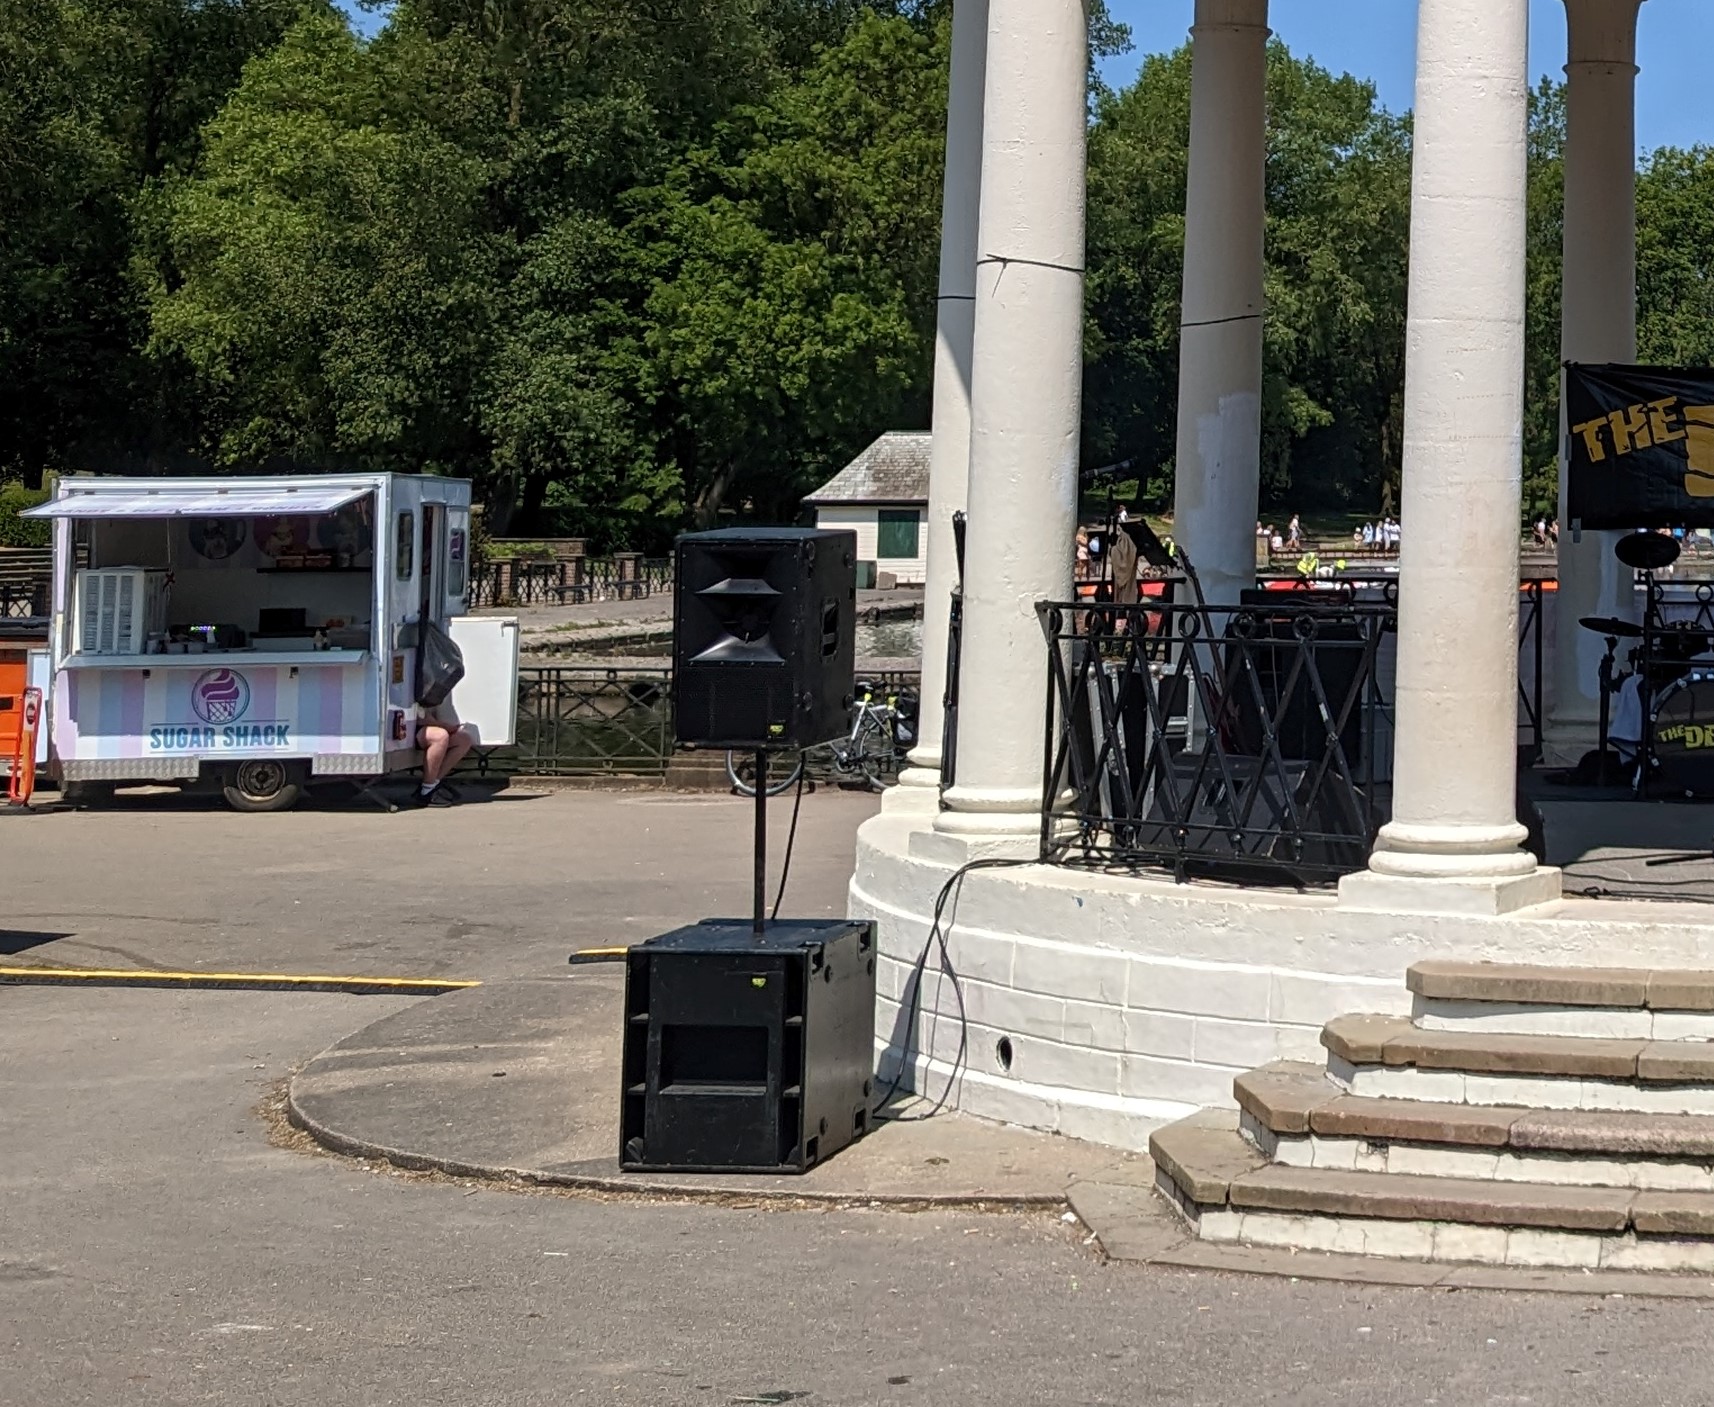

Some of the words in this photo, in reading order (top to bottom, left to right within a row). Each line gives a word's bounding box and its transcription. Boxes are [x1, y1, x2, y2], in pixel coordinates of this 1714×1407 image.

[1572, 395, 1690, 463] THE
[150, 727, 216, 749] SUGAR
[222, 724, 290, 747] SHACK
[1658, 724, 1685, 742] THE
